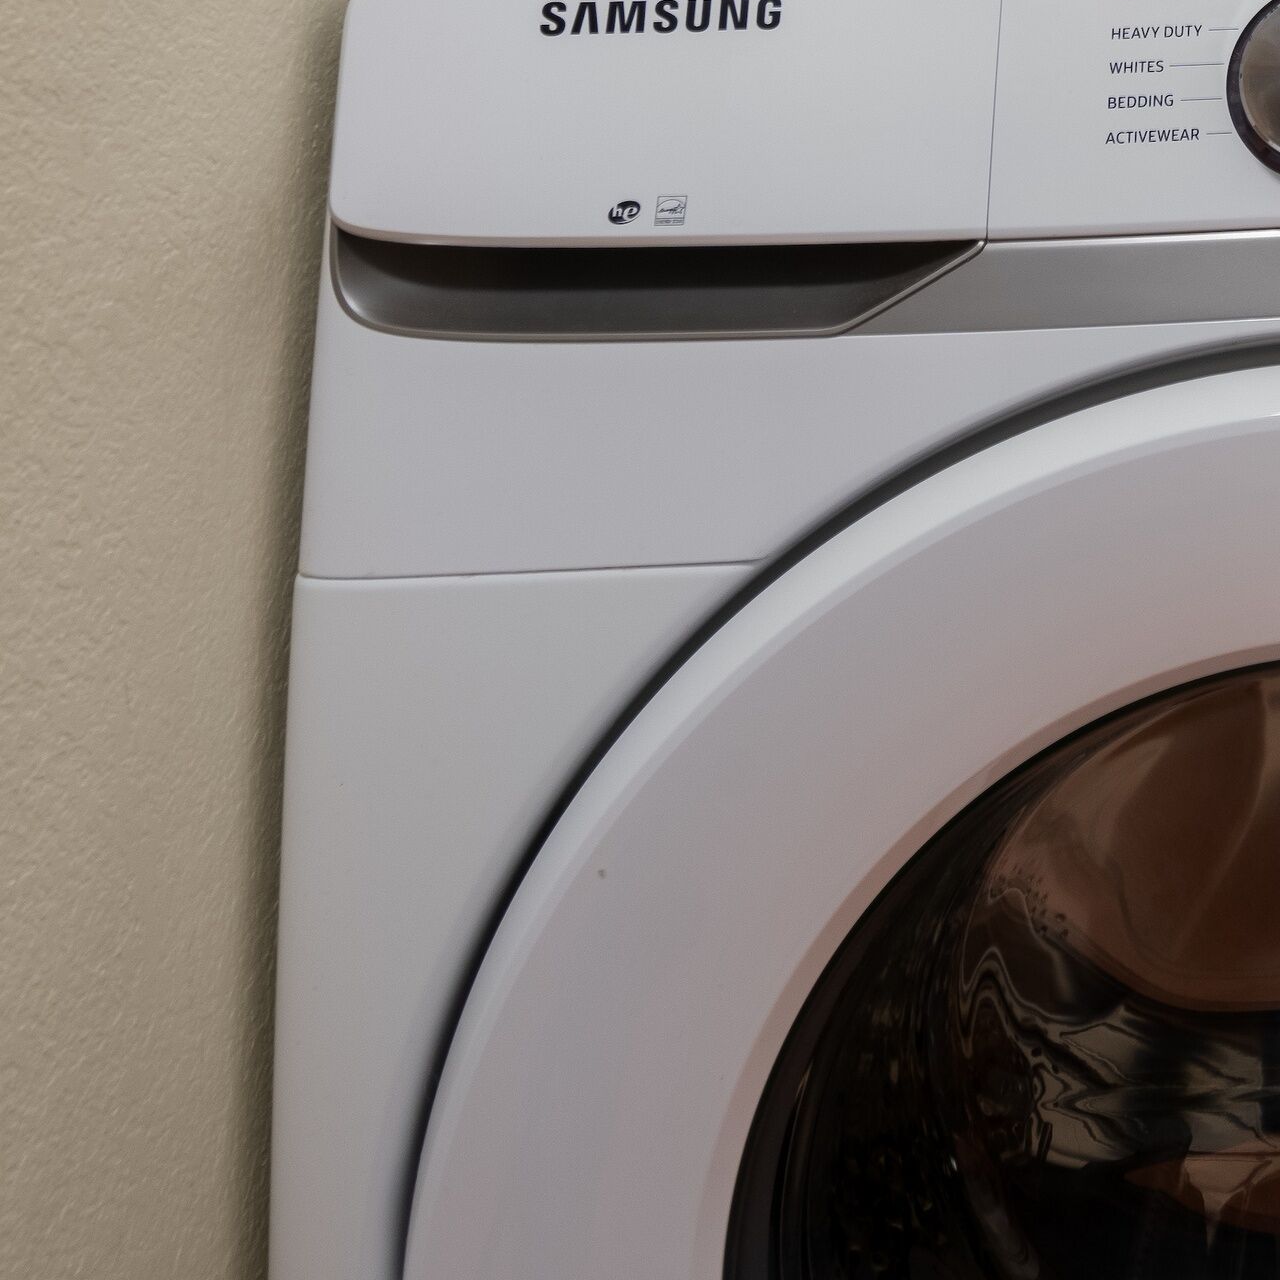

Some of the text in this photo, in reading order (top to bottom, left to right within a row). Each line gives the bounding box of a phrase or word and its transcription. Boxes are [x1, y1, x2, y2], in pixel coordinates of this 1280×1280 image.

[1111, 24, 1202, 40] HEAVY DUTY
[1109, 60, 1164, 74] WHITES
[1107, 95, 1174, 108] BEDDING
[1106, 128, 1200, 144] ACTIVEWEAR
